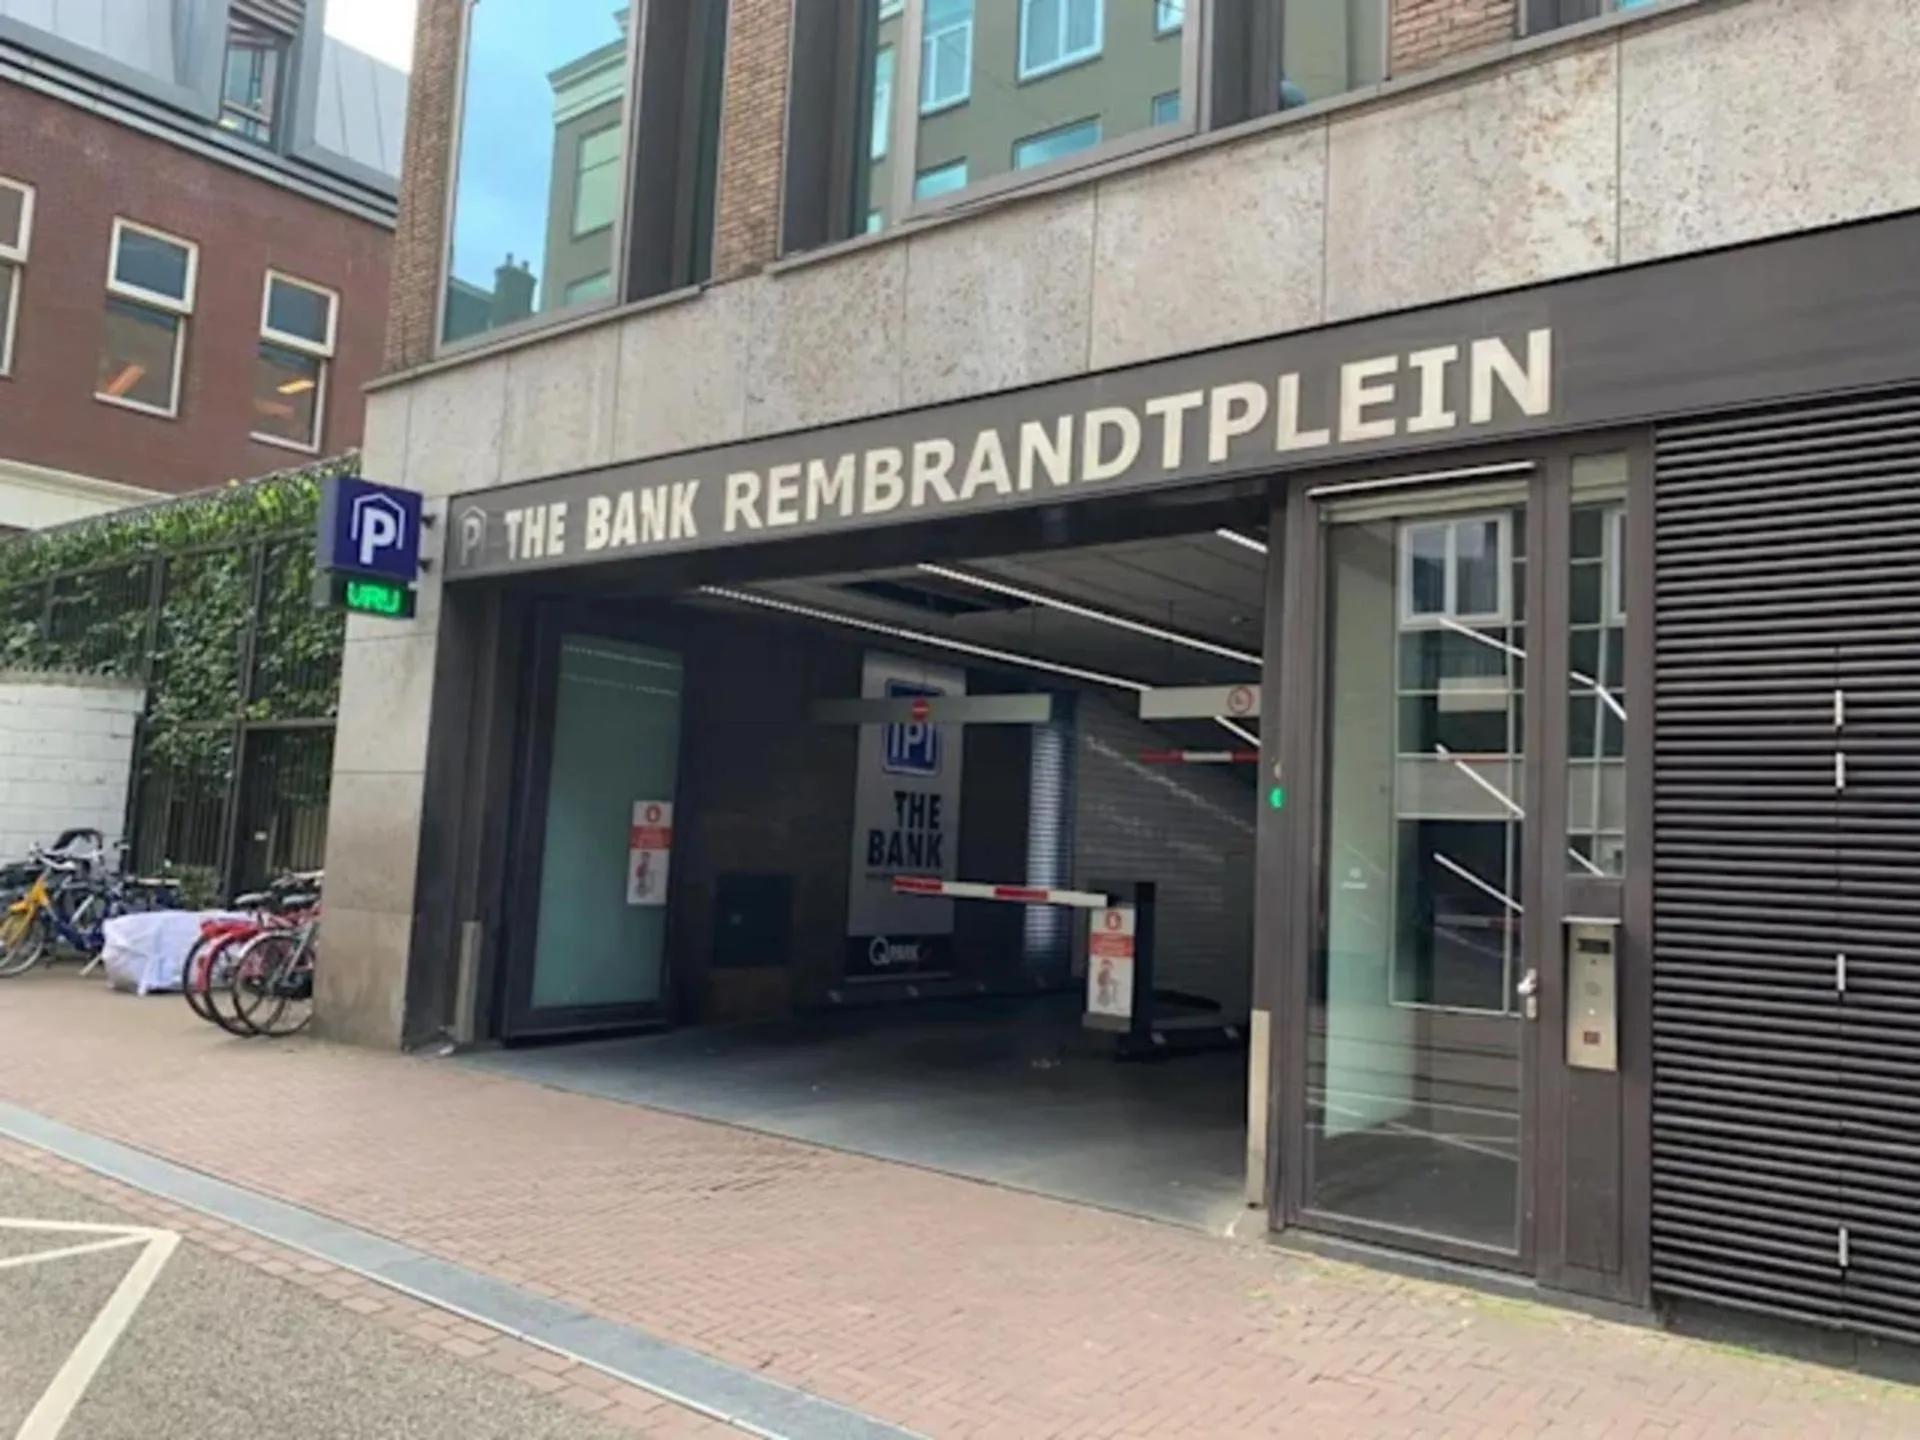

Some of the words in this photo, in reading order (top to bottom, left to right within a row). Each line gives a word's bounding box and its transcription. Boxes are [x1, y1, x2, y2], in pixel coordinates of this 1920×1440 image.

[504, 502, 568, 561] THE
[585, 479, 700, 551] BANK
[724, 328, 1552, 532] REMBRANDTPLEIN
[360, 506, 397, 565] P
[893, 790, 942, 830] THE
[866, 829, 944, 869] BANK
